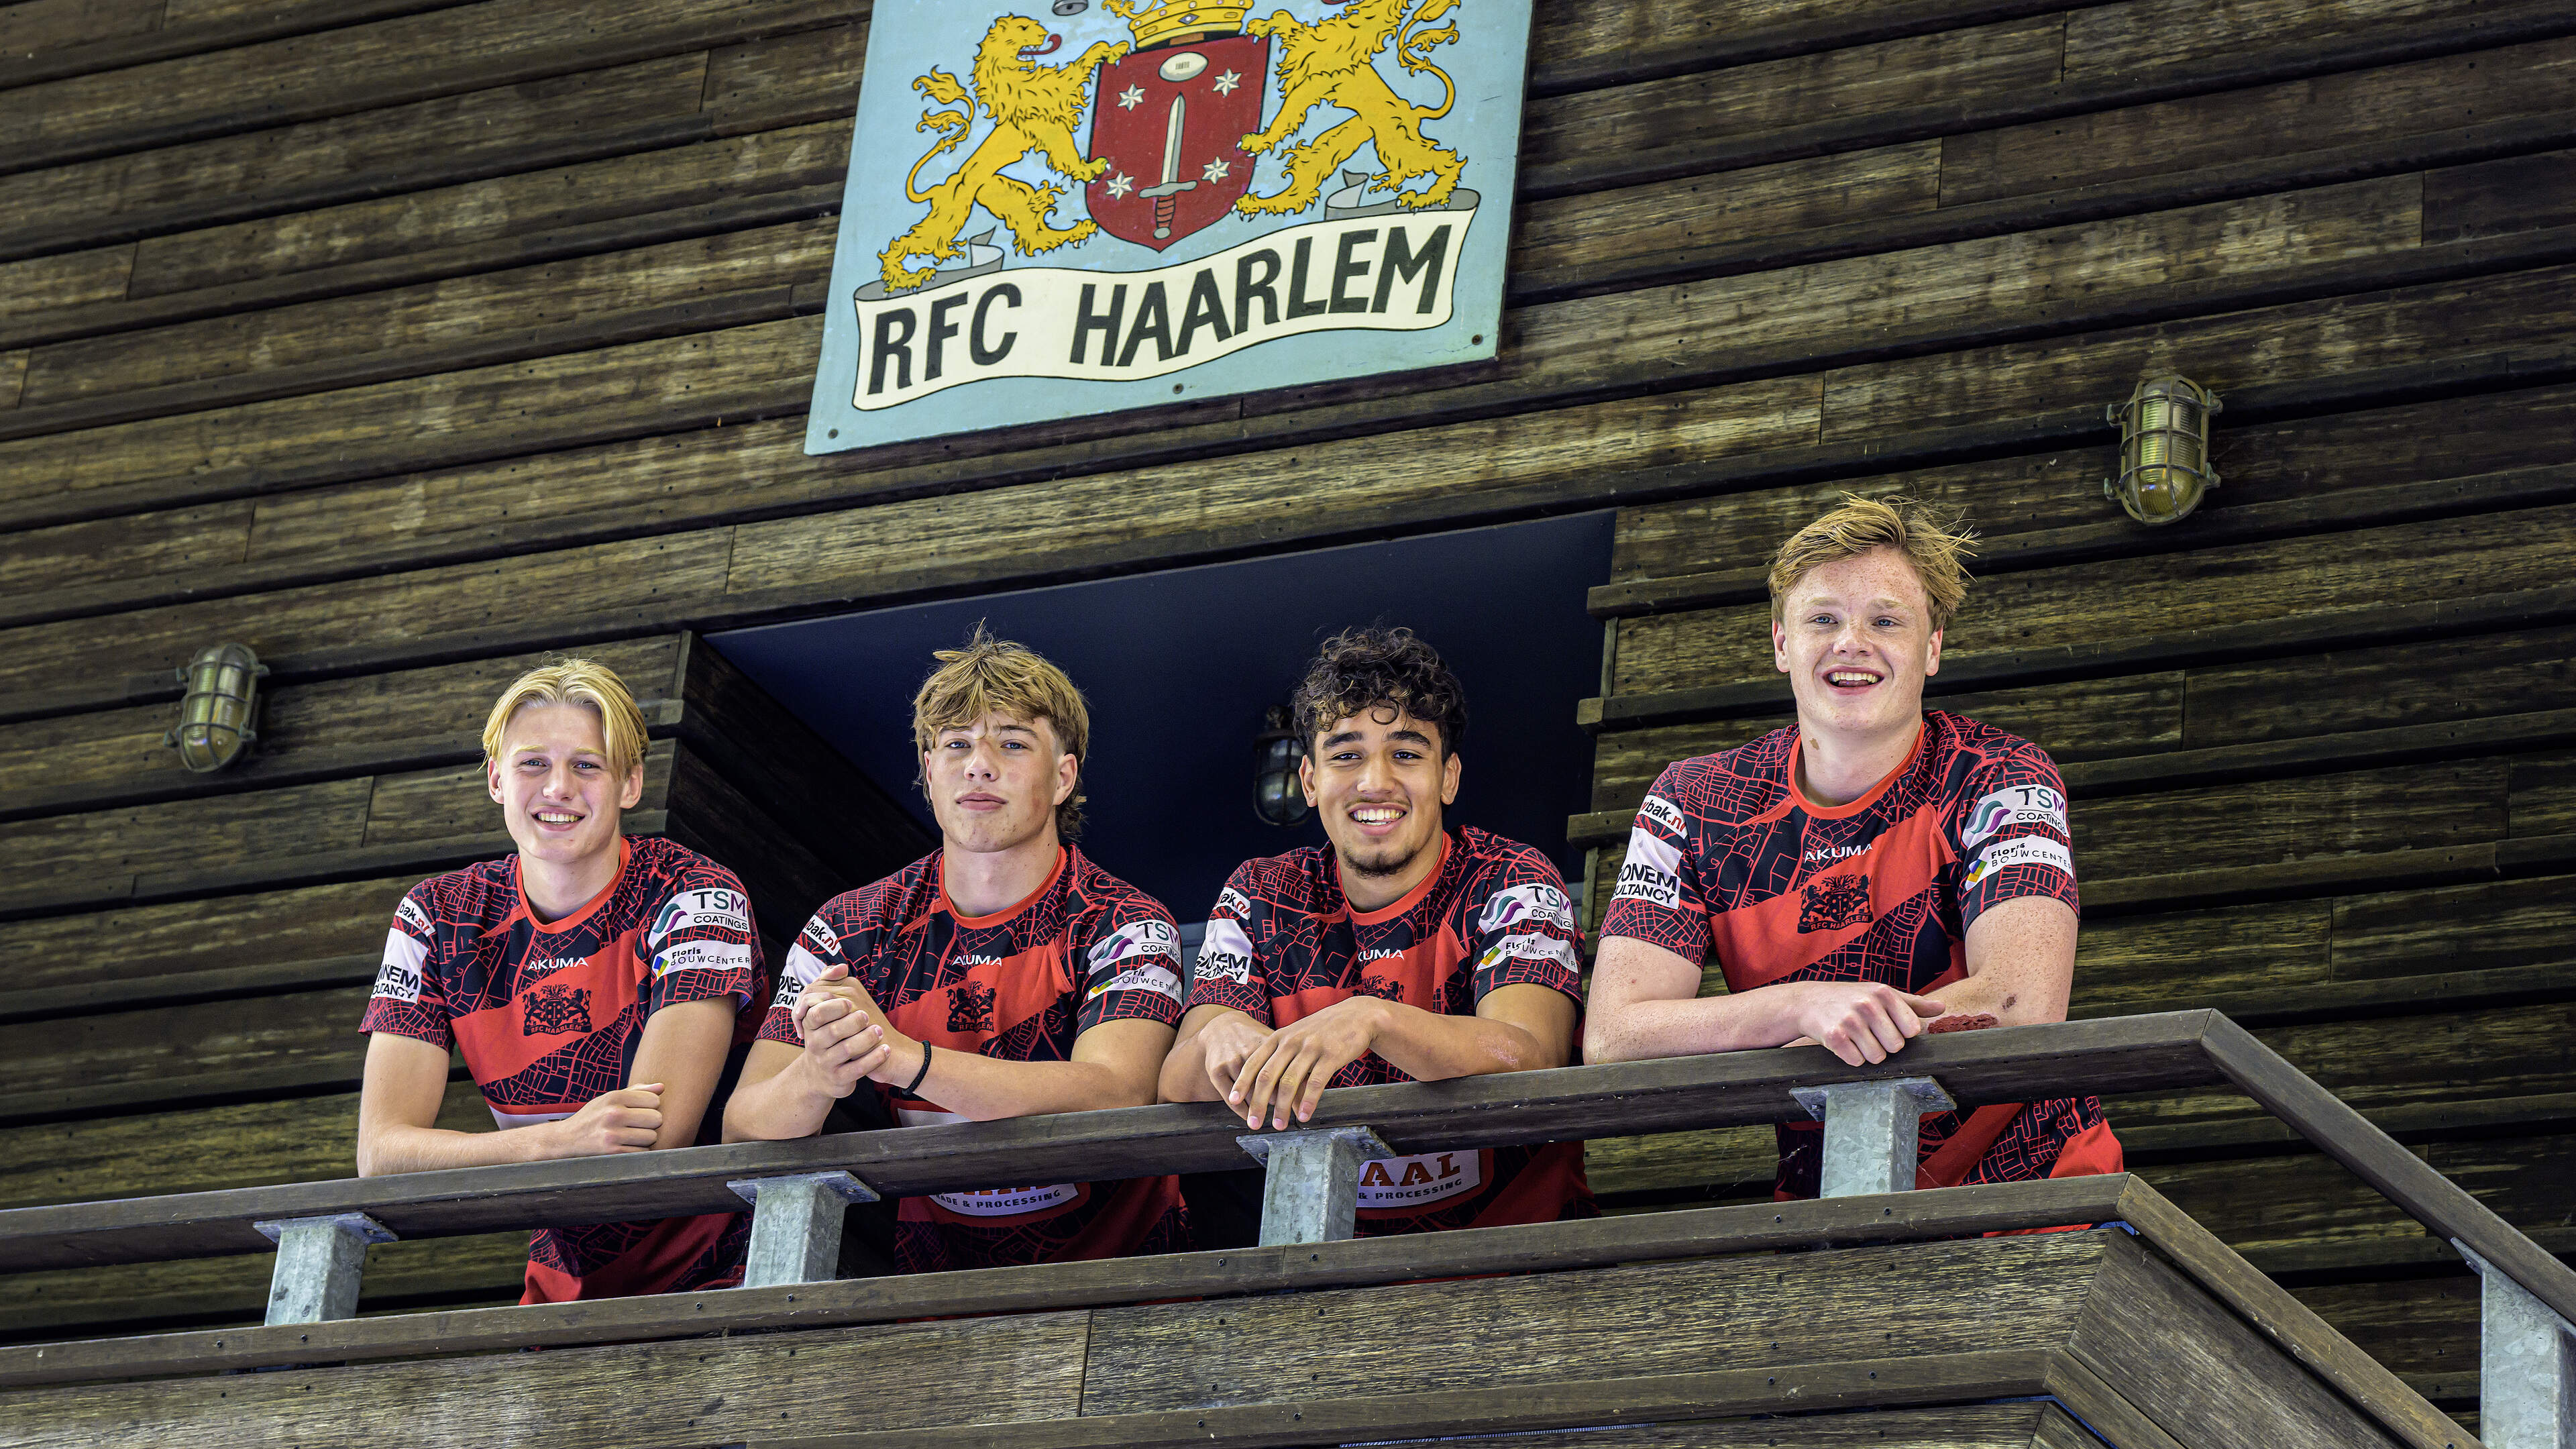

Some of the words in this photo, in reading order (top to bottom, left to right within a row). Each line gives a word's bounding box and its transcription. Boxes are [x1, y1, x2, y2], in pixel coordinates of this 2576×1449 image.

[867, 283, 1021, 394] RFC
[1070, 225, 1451, 367] HAARLEM
[2015, 787, 2064, 820] TSM
[1805, 844, 1873, 864] AKUMA
[1617, 863, 1677, 892] ONEM
[692, 891, 746, 917] TSM
[1526, 885, 1573, 917] TSM
[1613, 883, 1674, 904] ULTANCY
[397, 901, 430, 932] bak.nl
[694, 915, 748, 930] COATINGS
[1532, 909, 1574, 928] COATING
[1811, 922, 1828, 930] RFC
[805, 920, 839, 951] bak.nl
[1136, 922, 1180, 951] TSM
[672, 947, 701, 959] Floris
[527, 957, 588, 971] AKUMA
[545, 1024, 582, 1034] HAARLEM
[977, 1189, 1061, 1208] PROCESSING
[1375, 1179, 1462, 1200] PROCESSING
